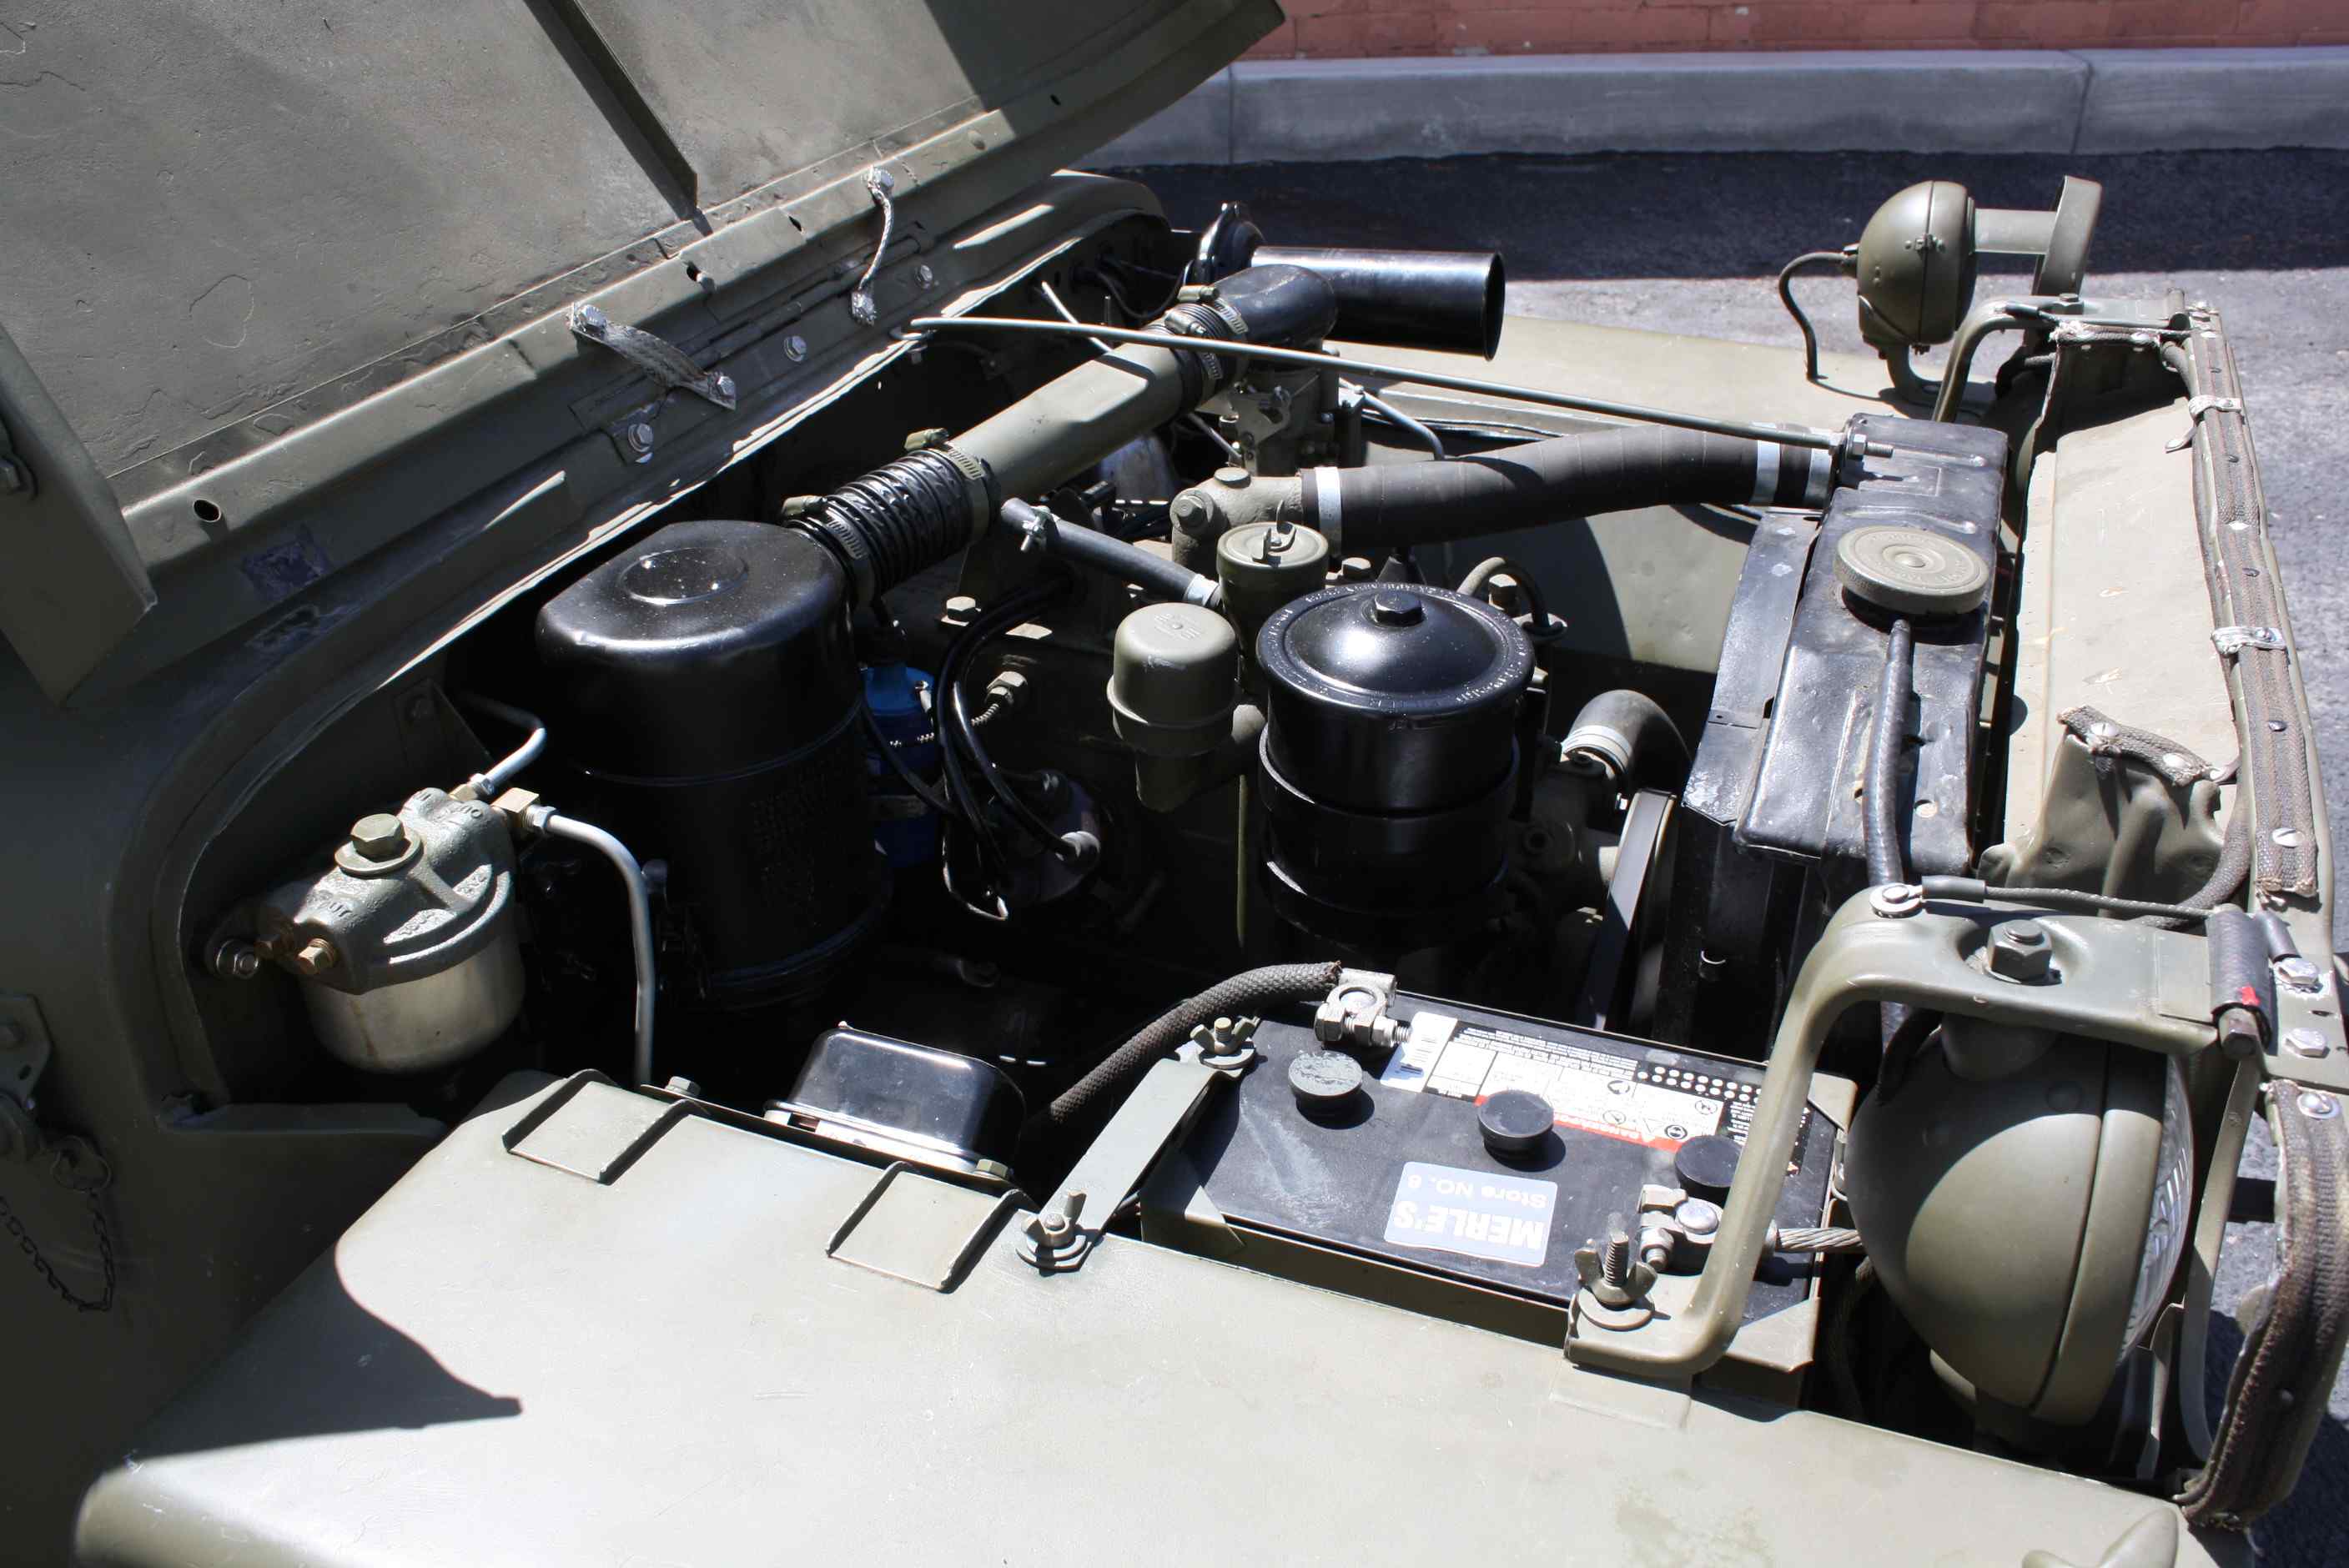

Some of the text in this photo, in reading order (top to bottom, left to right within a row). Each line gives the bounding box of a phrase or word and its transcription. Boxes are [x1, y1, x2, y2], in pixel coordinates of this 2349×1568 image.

[1429, 1177, 1473, 1201] NO.
[1481, 1185, 1549, 1209] Store
[1393, 1200, 1544, 1249] MERLE'S
